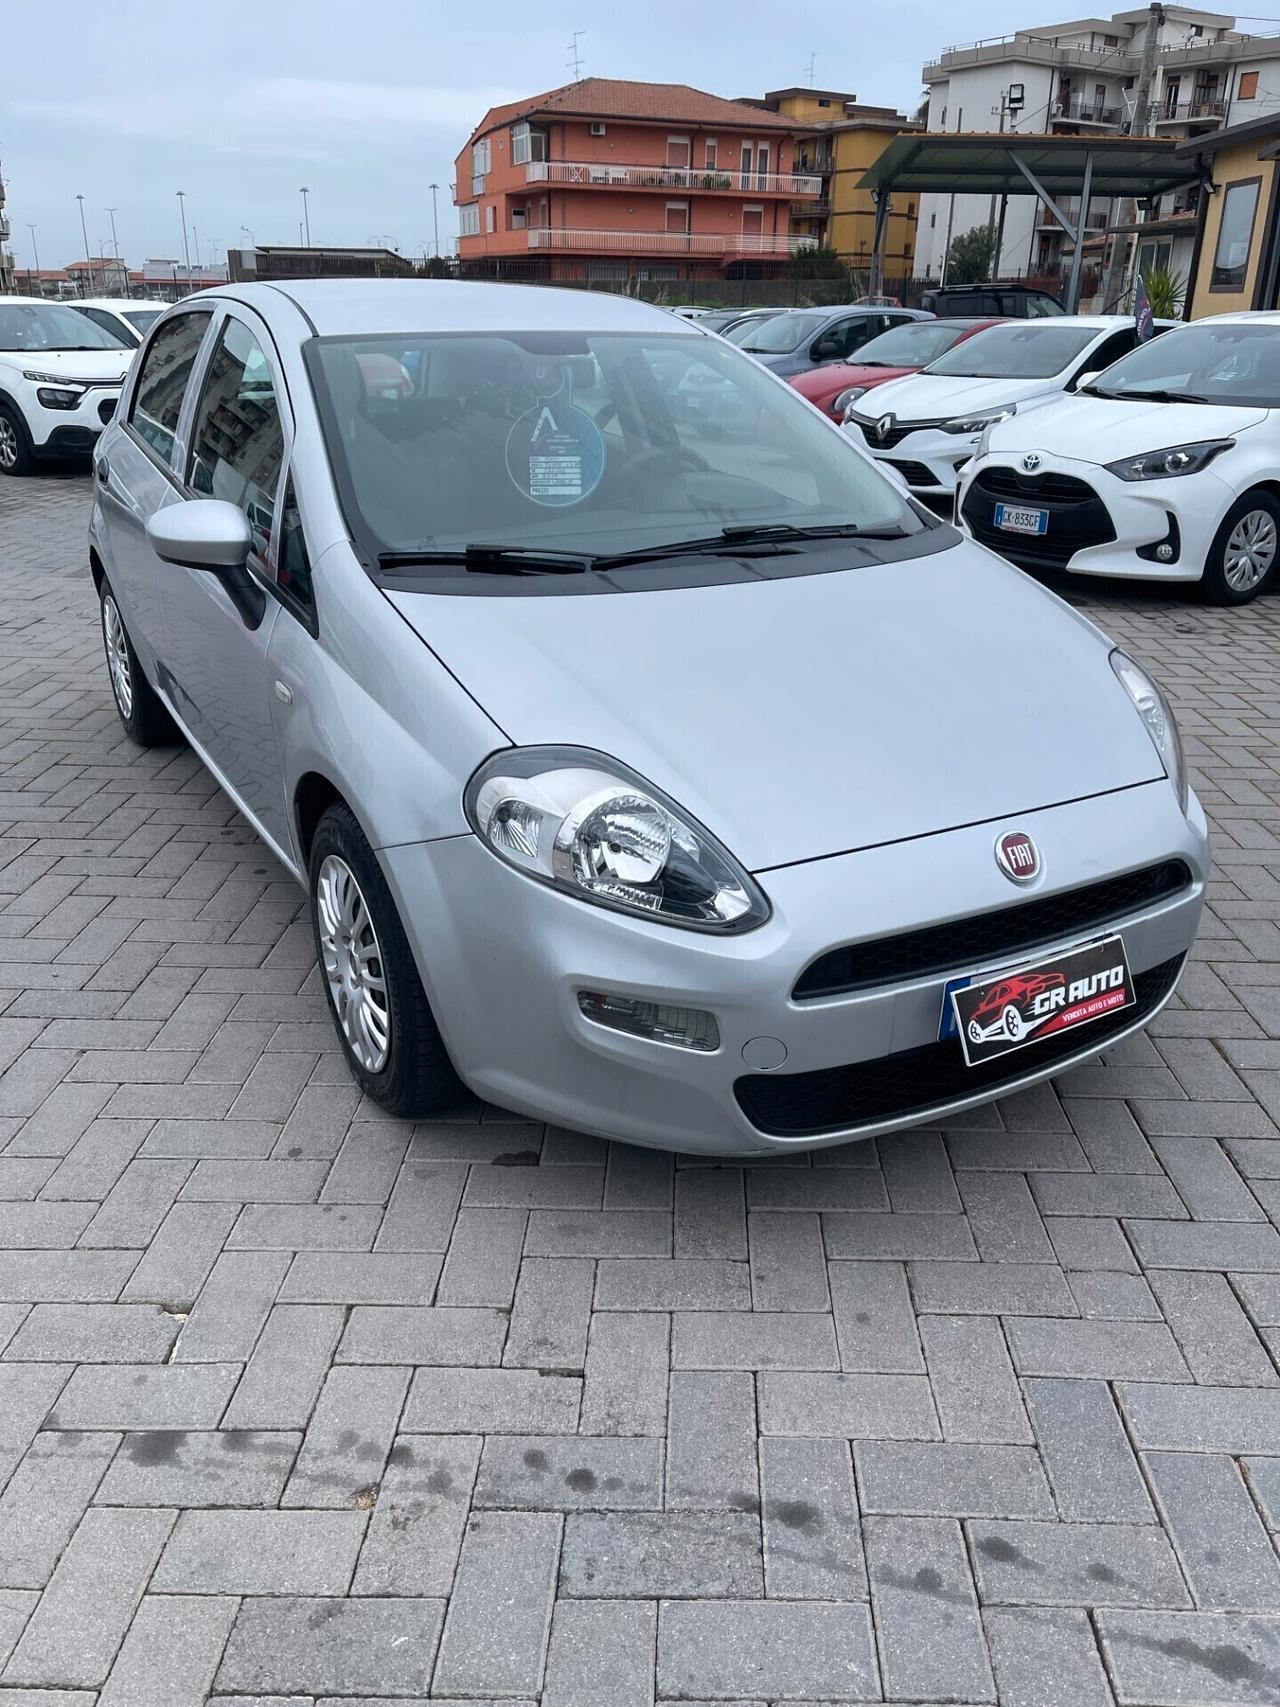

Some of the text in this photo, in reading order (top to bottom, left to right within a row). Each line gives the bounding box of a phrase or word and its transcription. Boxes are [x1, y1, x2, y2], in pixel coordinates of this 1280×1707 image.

[1007, 843, 1033, 868] FIAT
[1033, 965, 1124, 1015] GR AUTO
[1062, 994, 1124, 1023] VENDITA AUTO E MOTO
